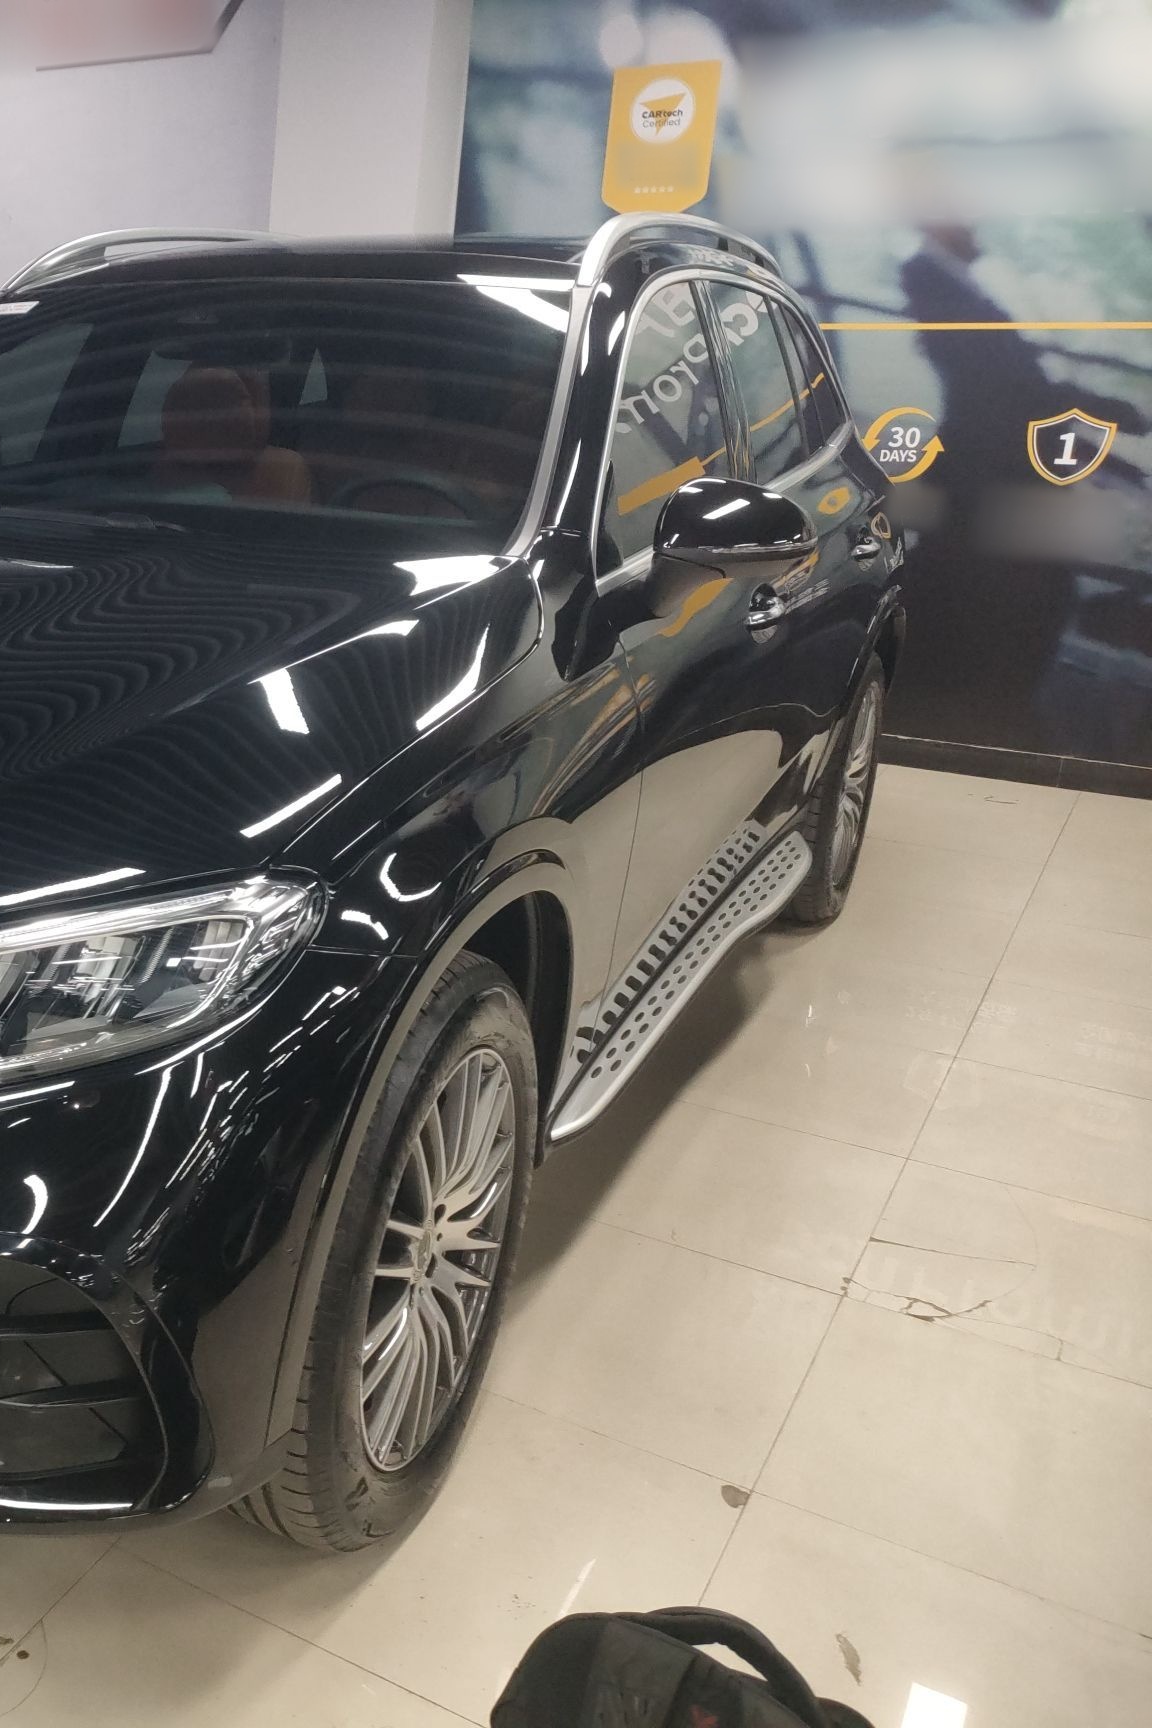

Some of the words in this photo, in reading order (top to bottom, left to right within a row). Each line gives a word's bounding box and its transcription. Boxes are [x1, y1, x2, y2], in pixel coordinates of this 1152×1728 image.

[888, 426, 921, 449] 30
[1053, 432, 1077, 466] 1
[880, 449, 917, 464] DAYS
